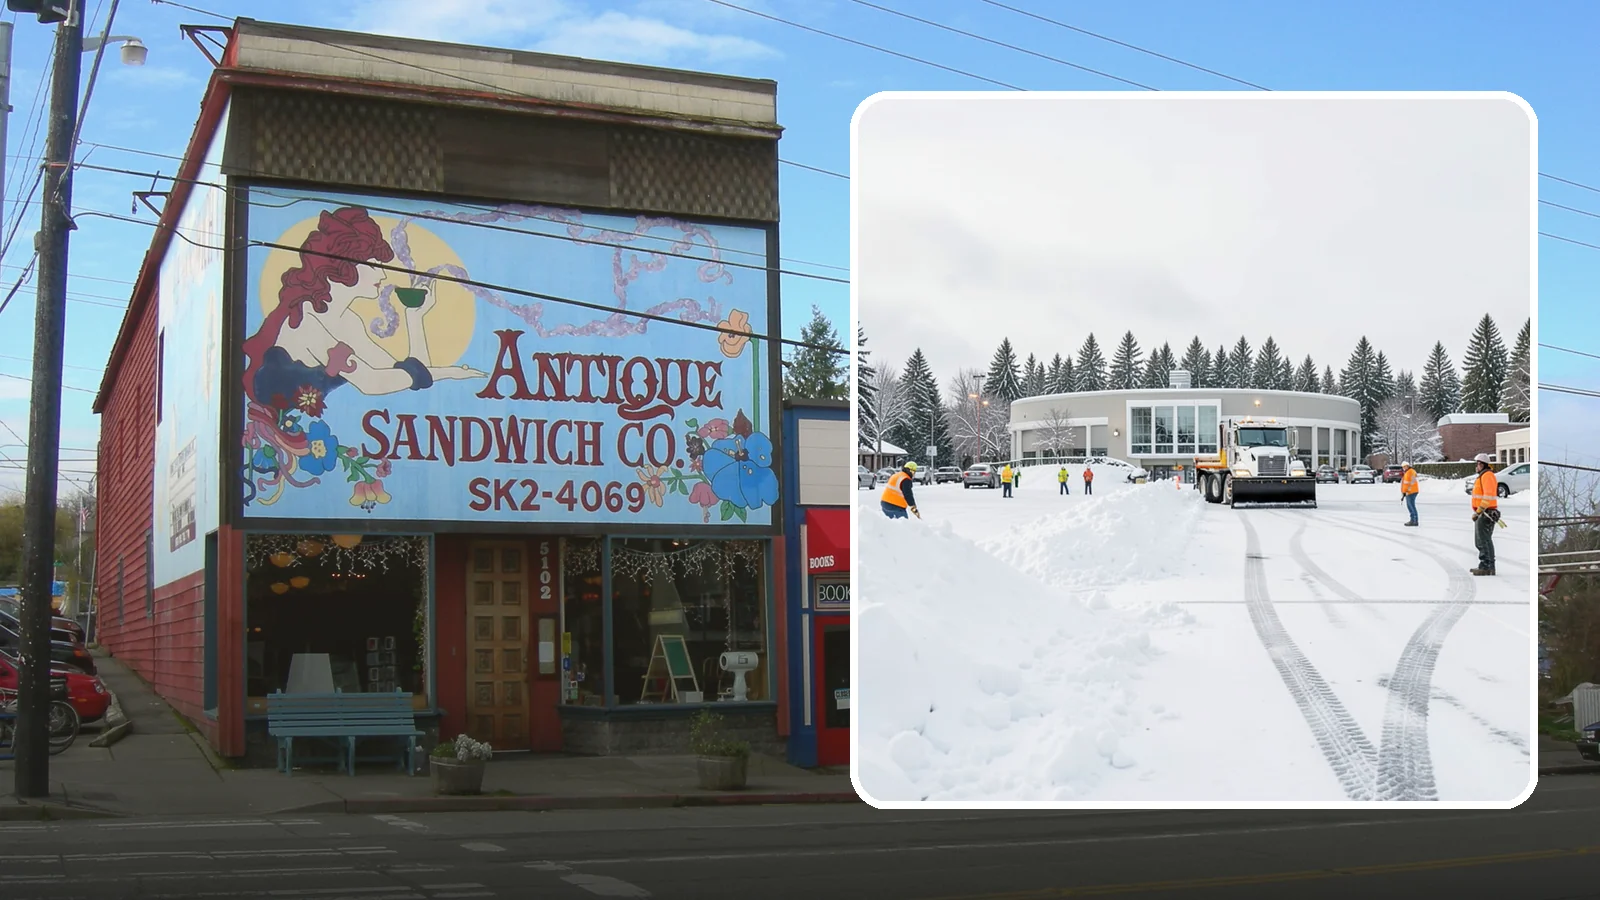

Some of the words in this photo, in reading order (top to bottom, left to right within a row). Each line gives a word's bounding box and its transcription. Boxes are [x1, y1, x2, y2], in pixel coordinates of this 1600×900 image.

[476, 329, 723, 421] ANTIQUE
[361, 408, 604, 467] SANDWICH
[617, 422, 685, 469] CO.
[469, 477, 645, 513] SK2-4069
[540, 542, 551, 600] 5102
[809, 555, 835, 569] BOOKS
